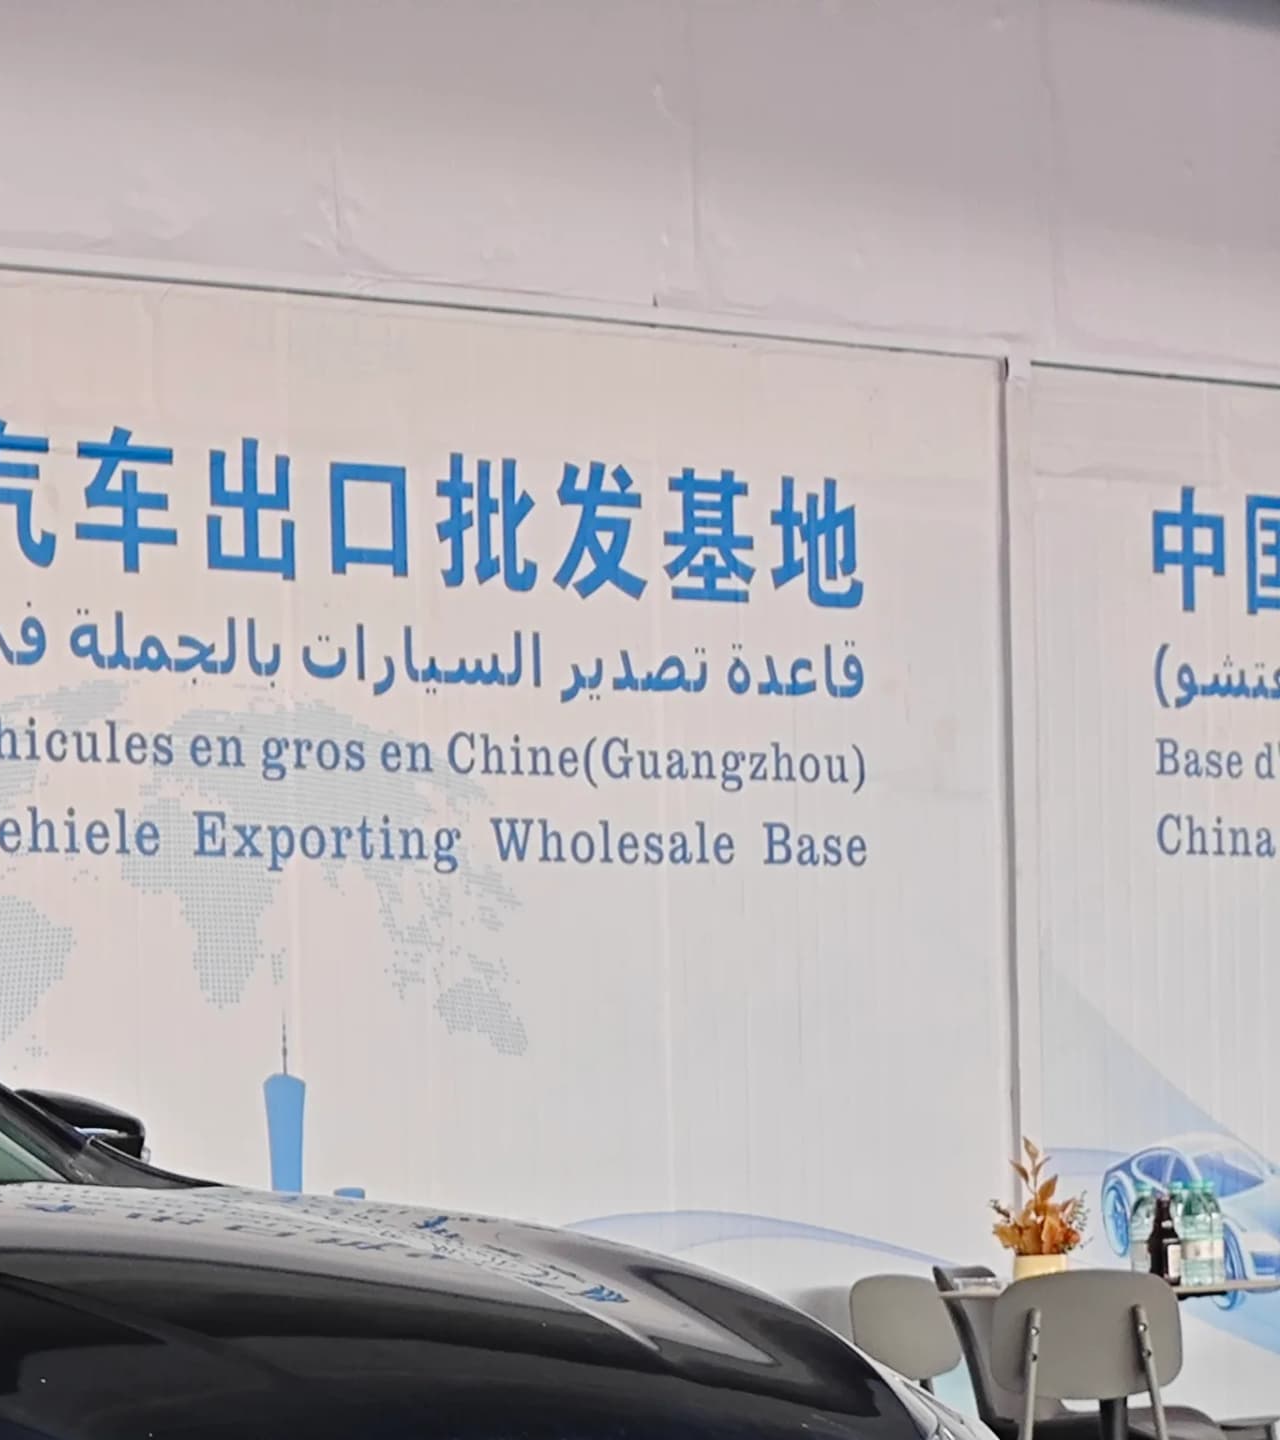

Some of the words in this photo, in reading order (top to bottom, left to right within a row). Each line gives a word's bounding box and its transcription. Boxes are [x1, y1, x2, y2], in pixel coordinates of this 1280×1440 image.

[69, 608, 281, 689] بالجملة
[303, 624, 542, 696] السيارات
[561, 645, 708, 703] تصدير
[728, 641, 865, 699] قاعدة
[189, 737, 244, 769] en
[262, 738, 367, 780] gros
[381, 743, 435, 772] en
[447, 731, 867, 793] Chine(Guangzhou)
[1155, 737, 1244, 779] Base
[193, 810, 462, 872] Exporting
[490, 816, 736, 866] Wholesale
[762, 820, 868, 867] Base
[1156, 813, 1277, 859] China
